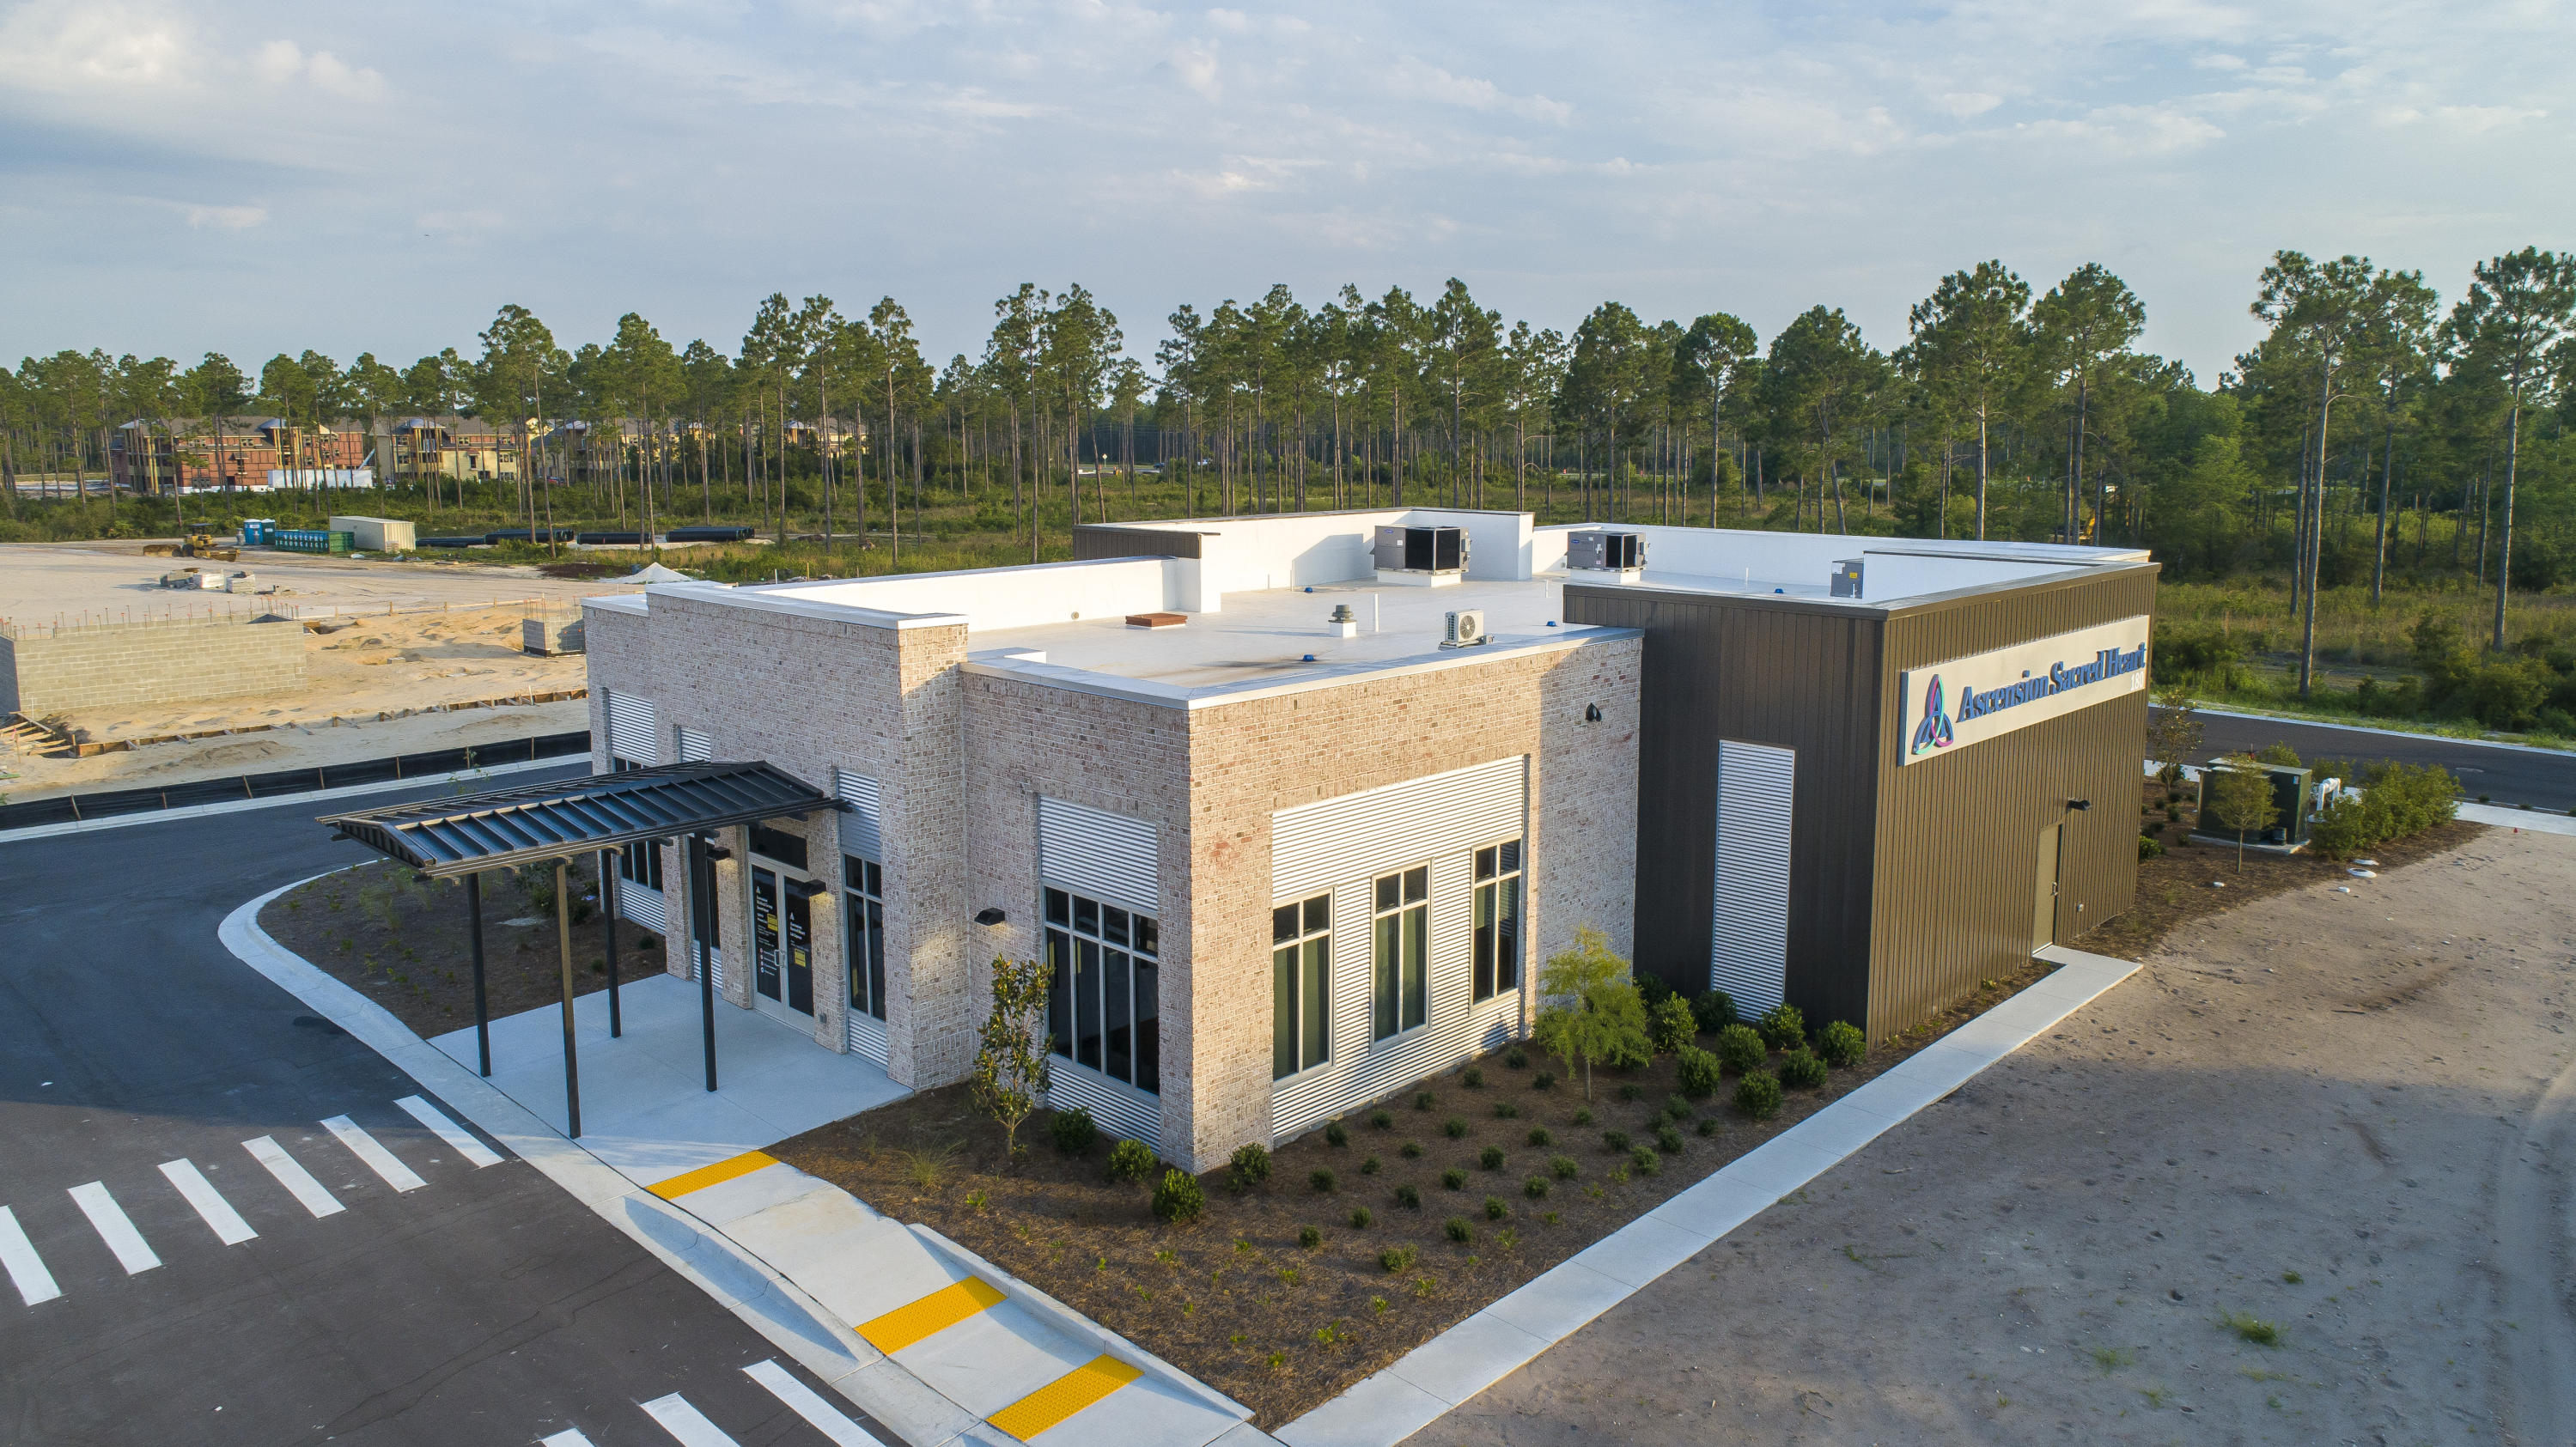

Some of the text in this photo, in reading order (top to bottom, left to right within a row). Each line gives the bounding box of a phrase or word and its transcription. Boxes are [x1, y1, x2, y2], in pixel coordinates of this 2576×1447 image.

[1956, 641, 2147, 723] Ascension Sacred Heart
[2130, 671, 2144, 691] 180
